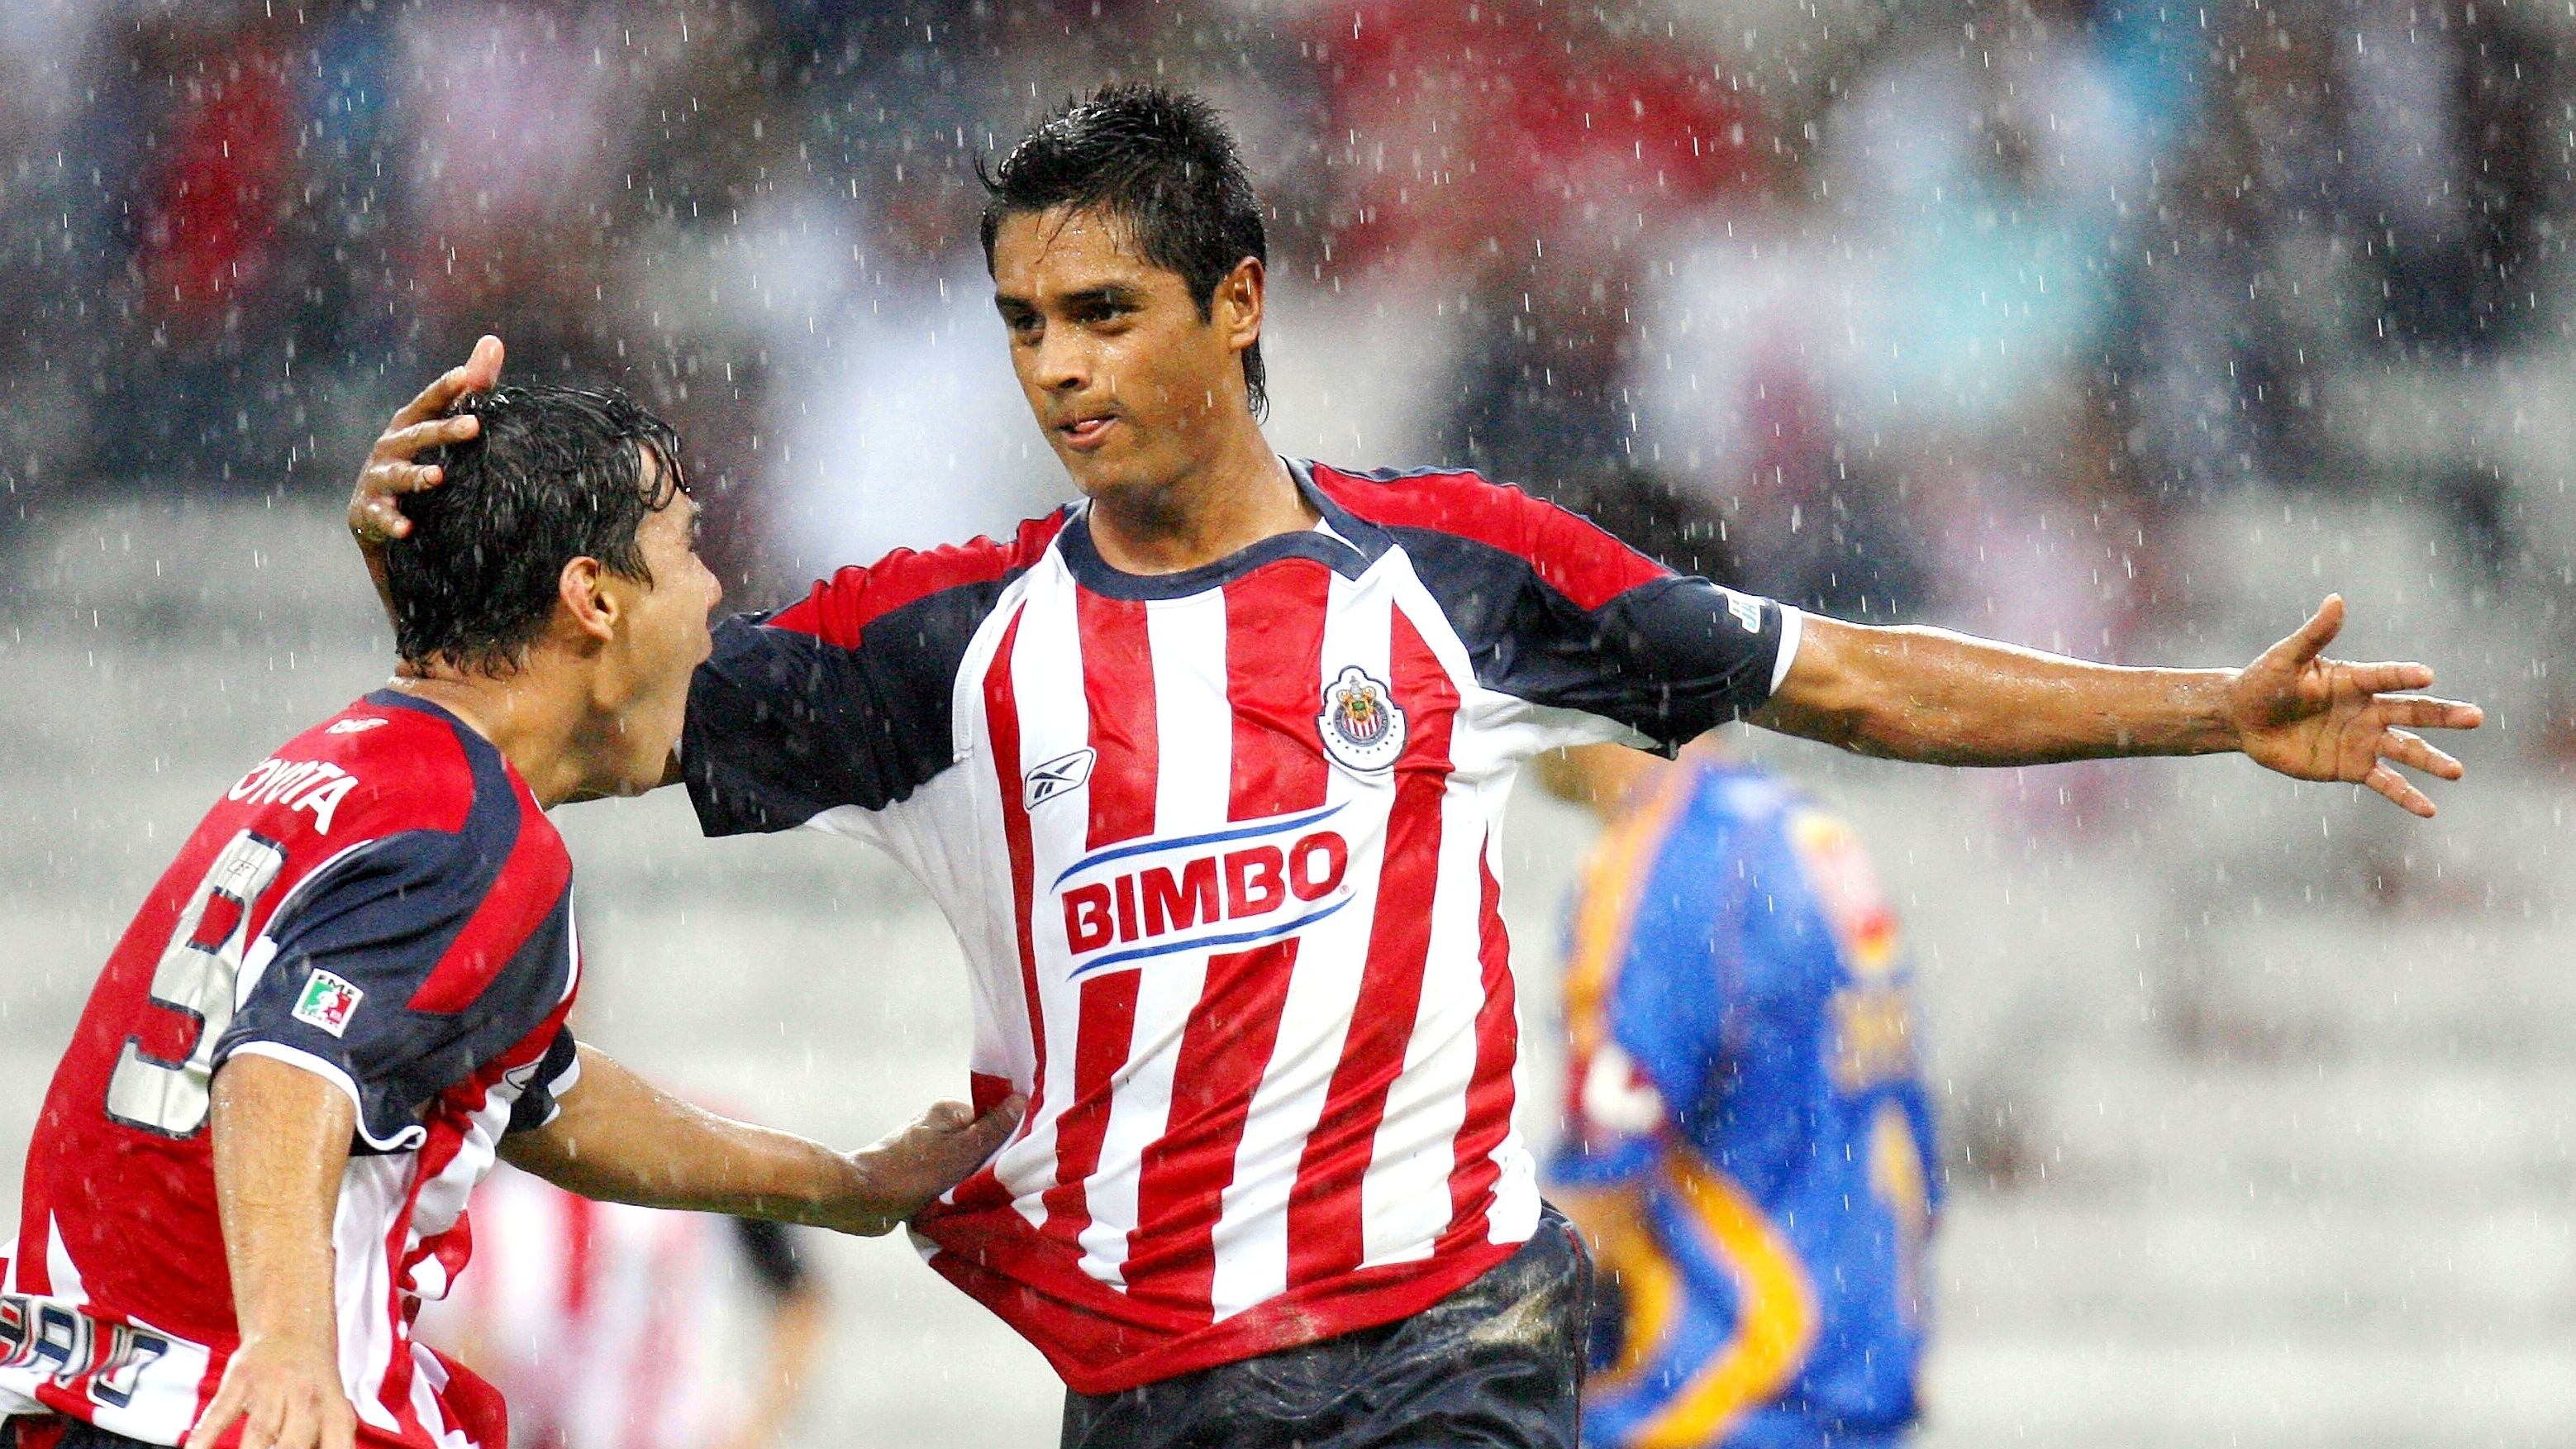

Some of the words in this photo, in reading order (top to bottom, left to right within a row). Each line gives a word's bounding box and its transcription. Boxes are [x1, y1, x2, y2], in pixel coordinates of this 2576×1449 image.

[228, 757, 359, 836] OYOTA
[1062, 831, 1348, 956] BIMBO
[104, 828, 289, 1140] 9
